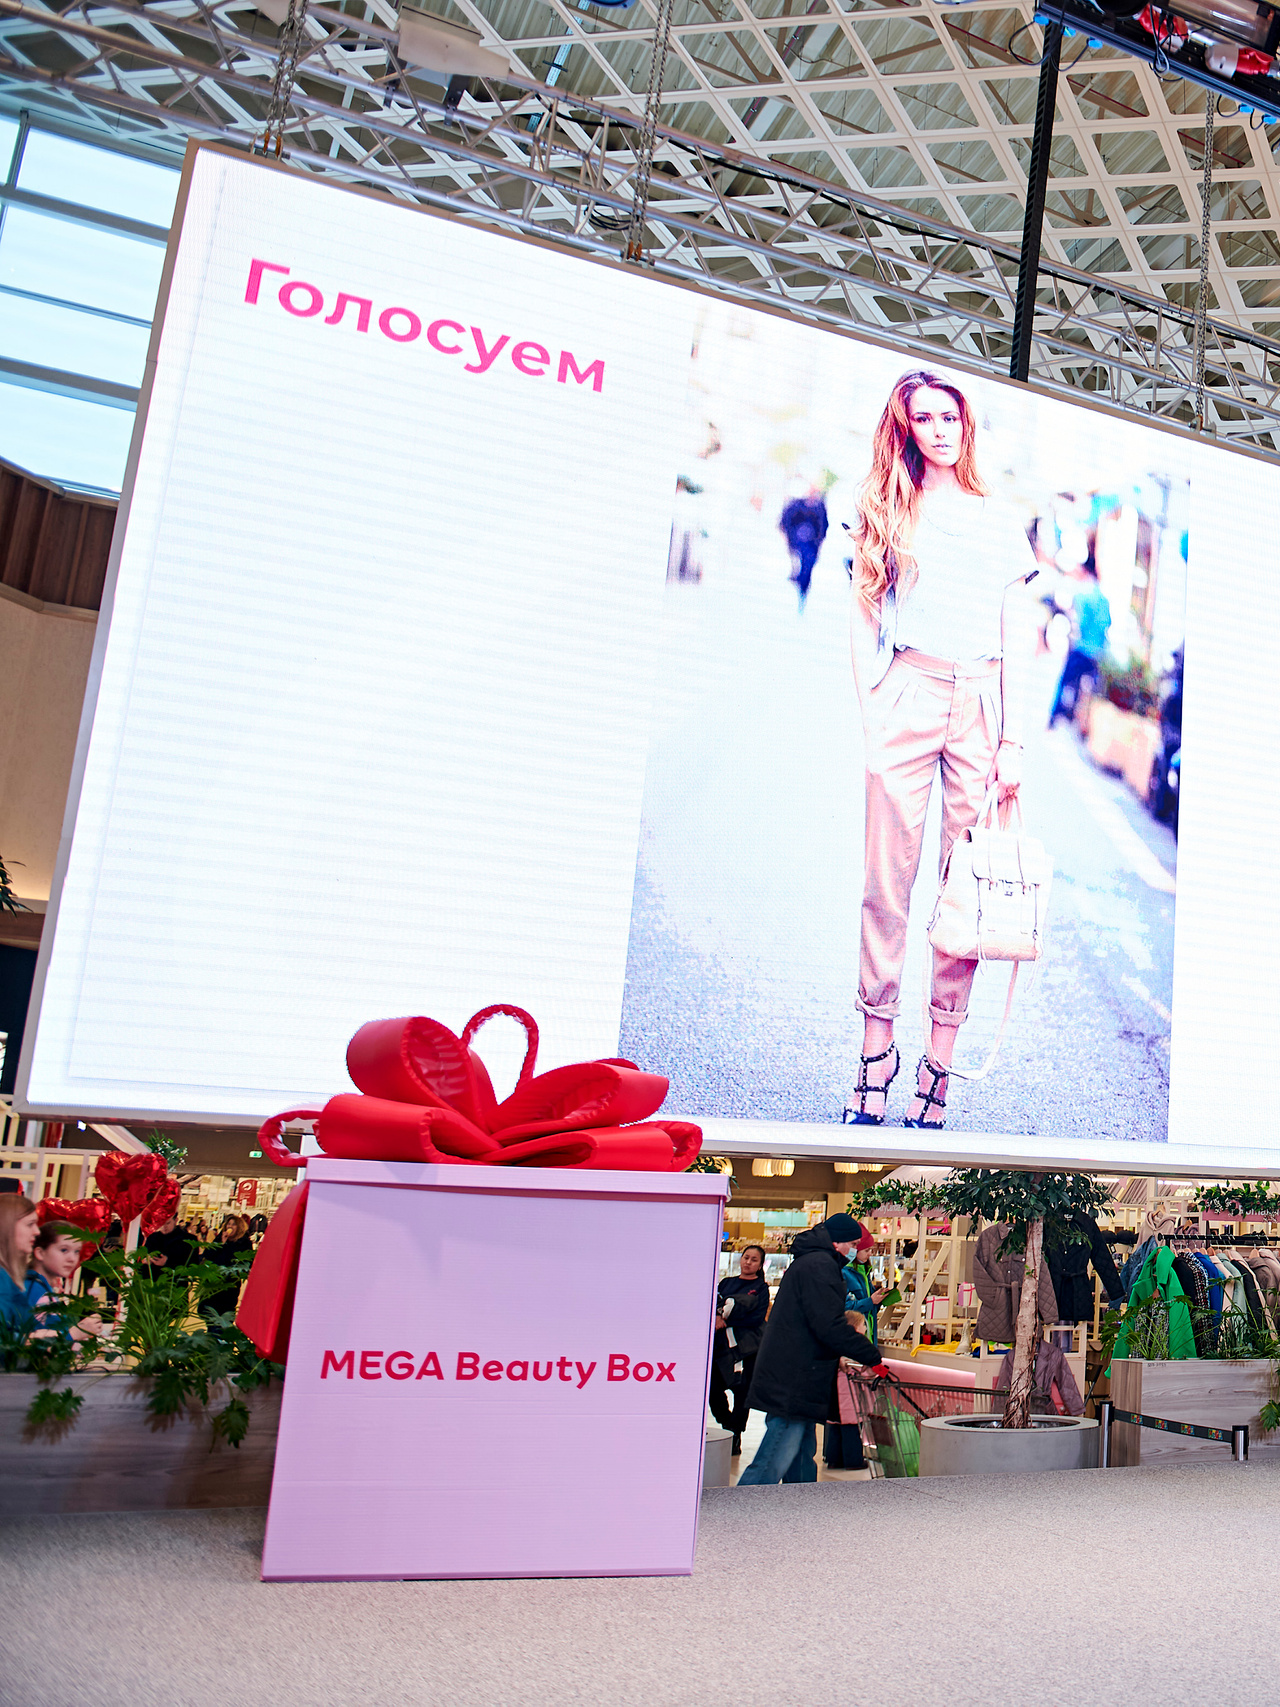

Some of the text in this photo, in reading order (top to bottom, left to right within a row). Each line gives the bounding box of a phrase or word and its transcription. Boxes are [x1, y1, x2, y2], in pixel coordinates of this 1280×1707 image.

[244, 258, 606, 393] Голосуем
[320, 1350, 677, 1390] MEGA Beauty Box
